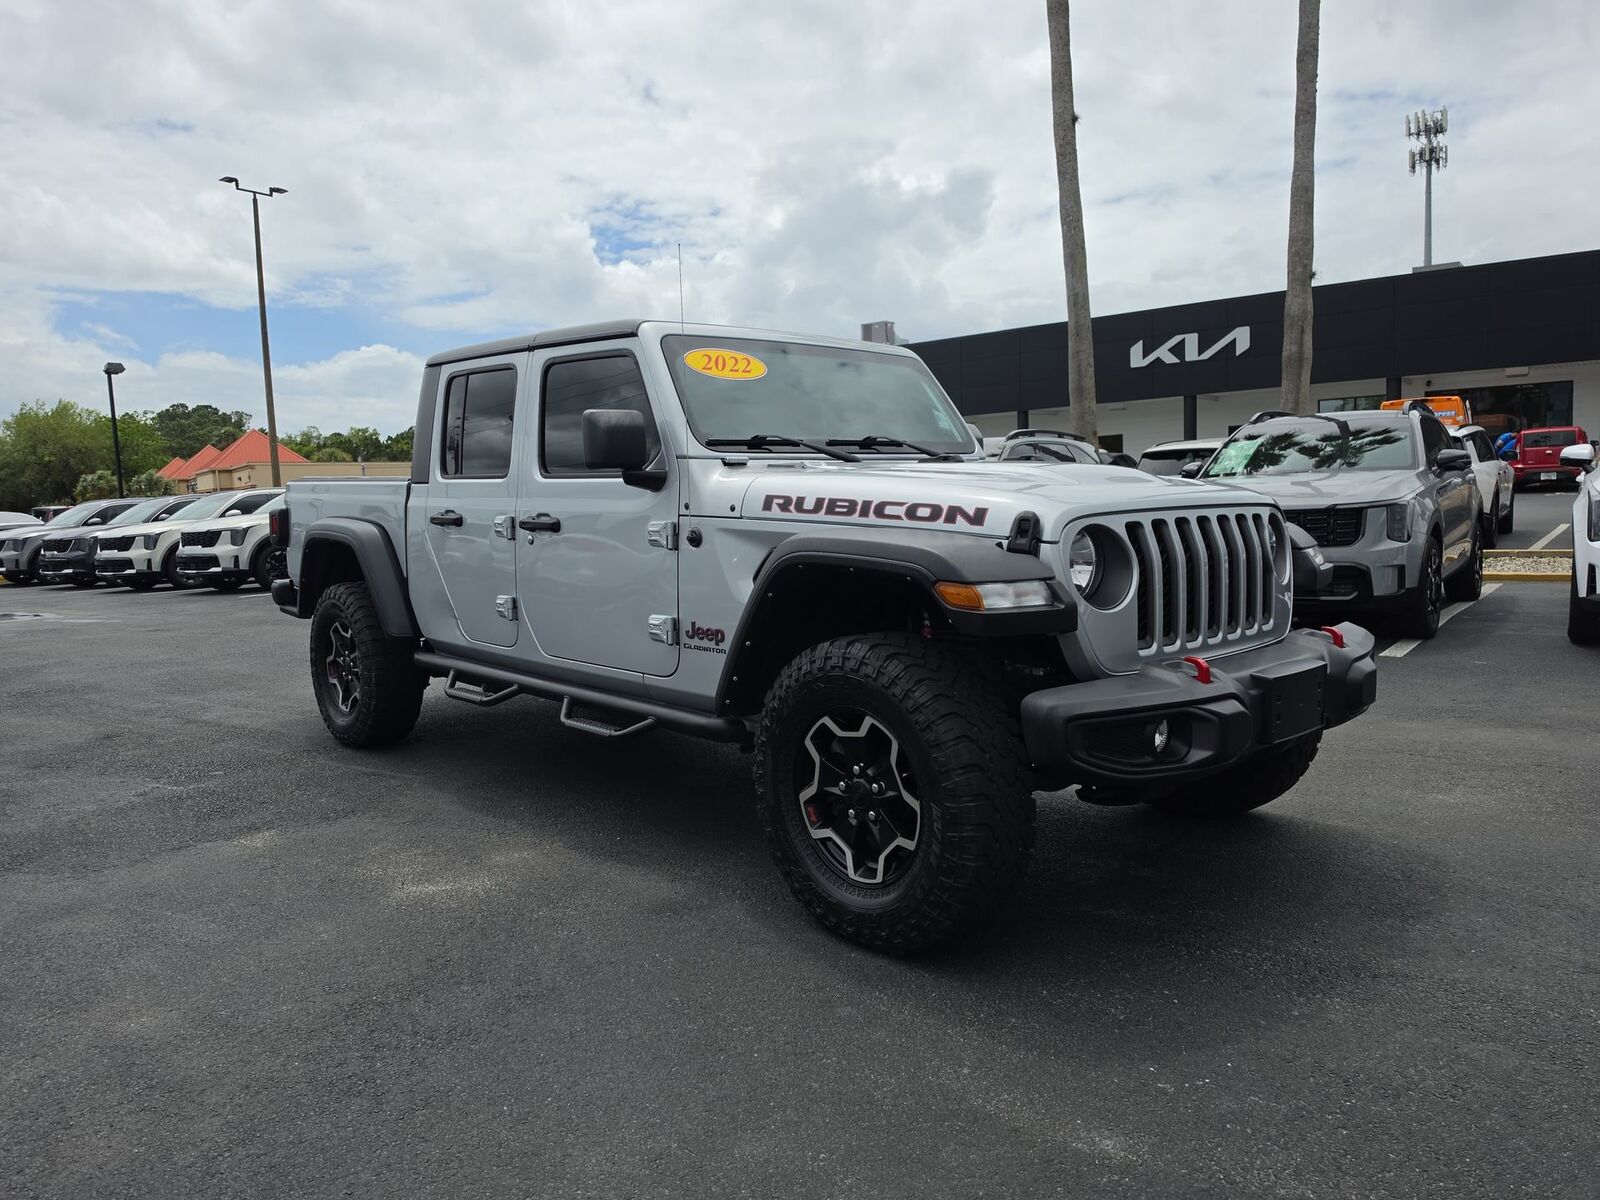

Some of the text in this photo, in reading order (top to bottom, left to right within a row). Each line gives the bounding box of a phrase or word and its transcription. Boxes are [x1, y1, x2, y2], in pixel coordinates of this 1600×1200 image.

[1130, 326, 1250, 368] KIA
[702, 353, 752, 373] 2022
[761, 494, 989, 526] RUBICON
[685, 621, 725, 646] Jeep
[683, 643, 727, 655] GLADIATOR
